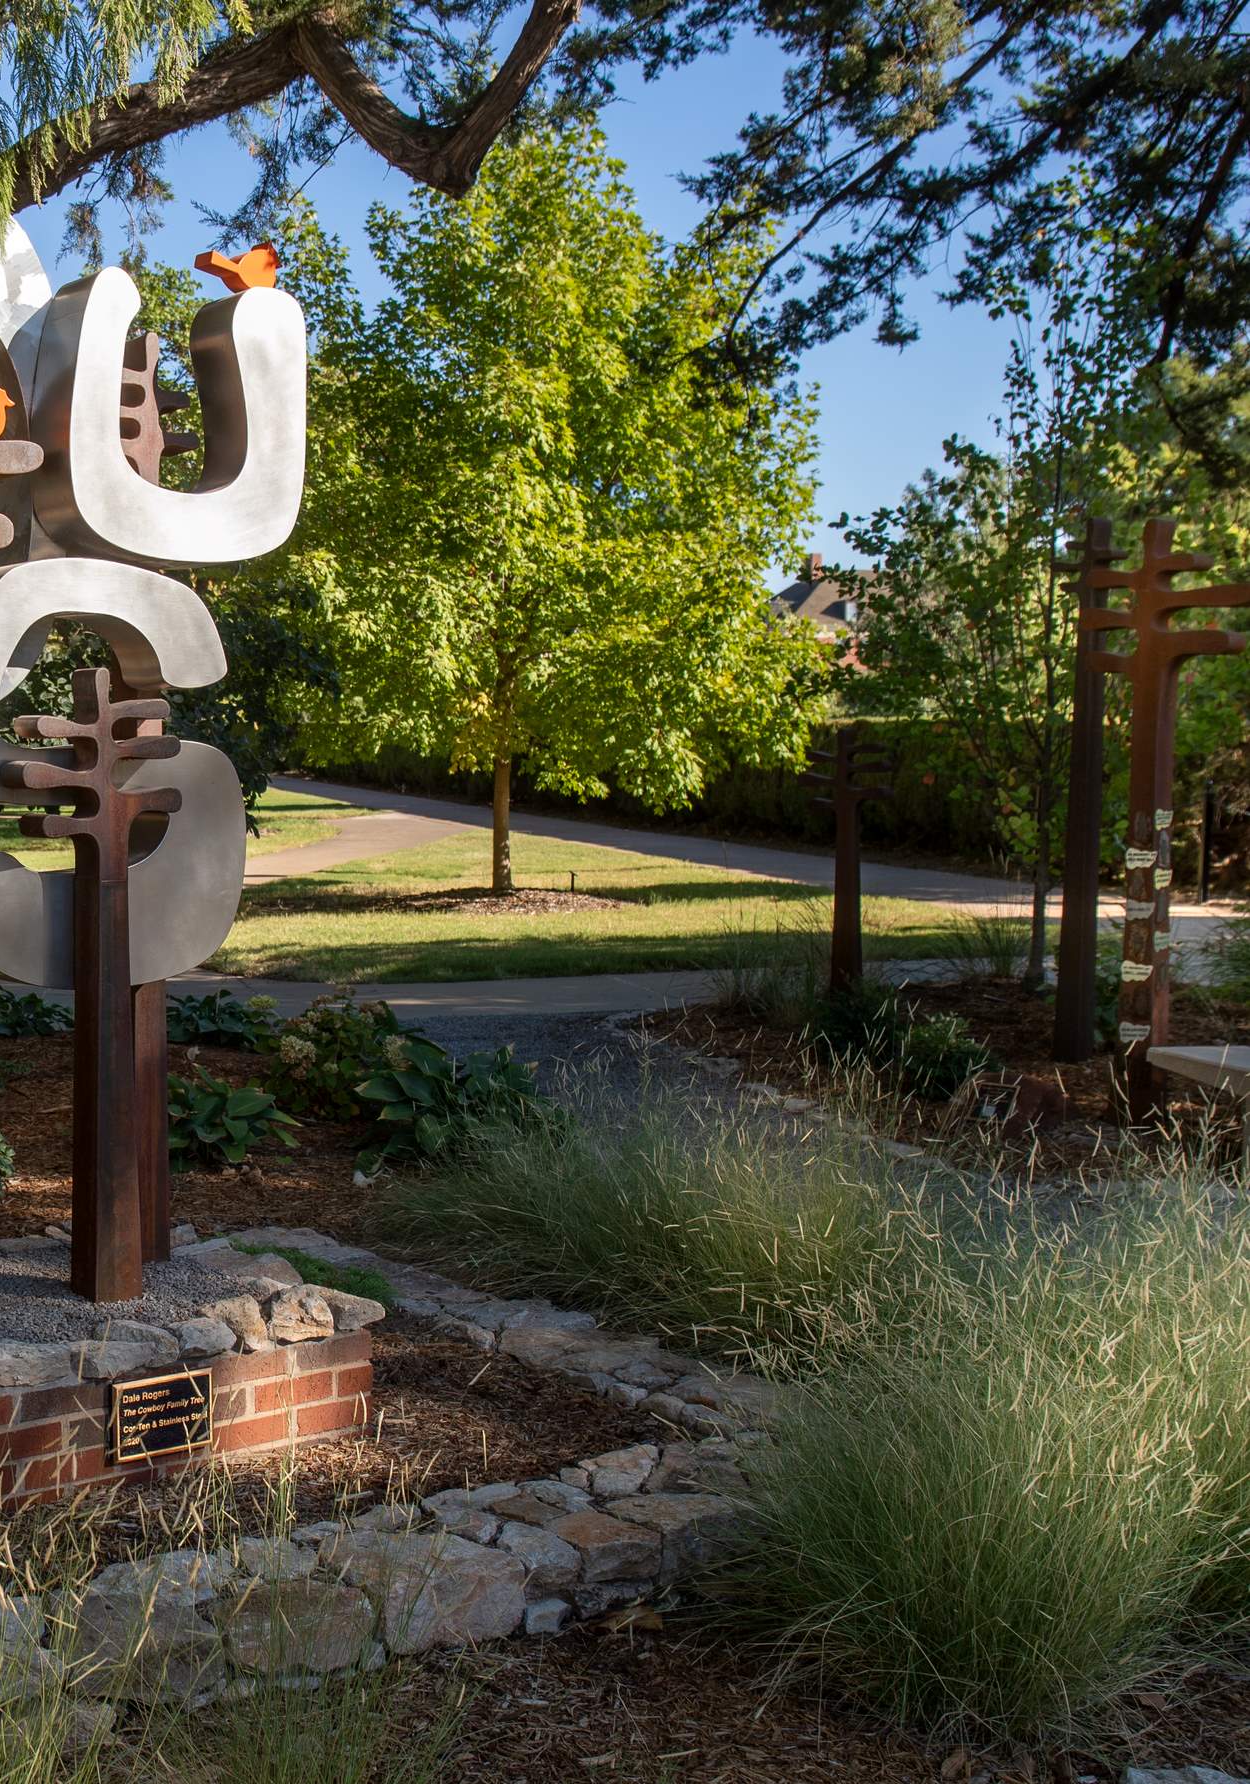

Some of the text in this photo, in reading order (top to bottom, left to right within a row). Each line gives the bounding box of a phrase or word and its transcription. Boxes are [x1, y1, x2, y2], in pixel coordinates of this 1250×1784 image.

[123, 1389, 170, 1403] Dale Rogers
[124, 1396, 205, 1417] The Cowboy Family Tree
[159, 1415, 190, 1427] Stainless
[191, 1410, 207, 1421] Stel
